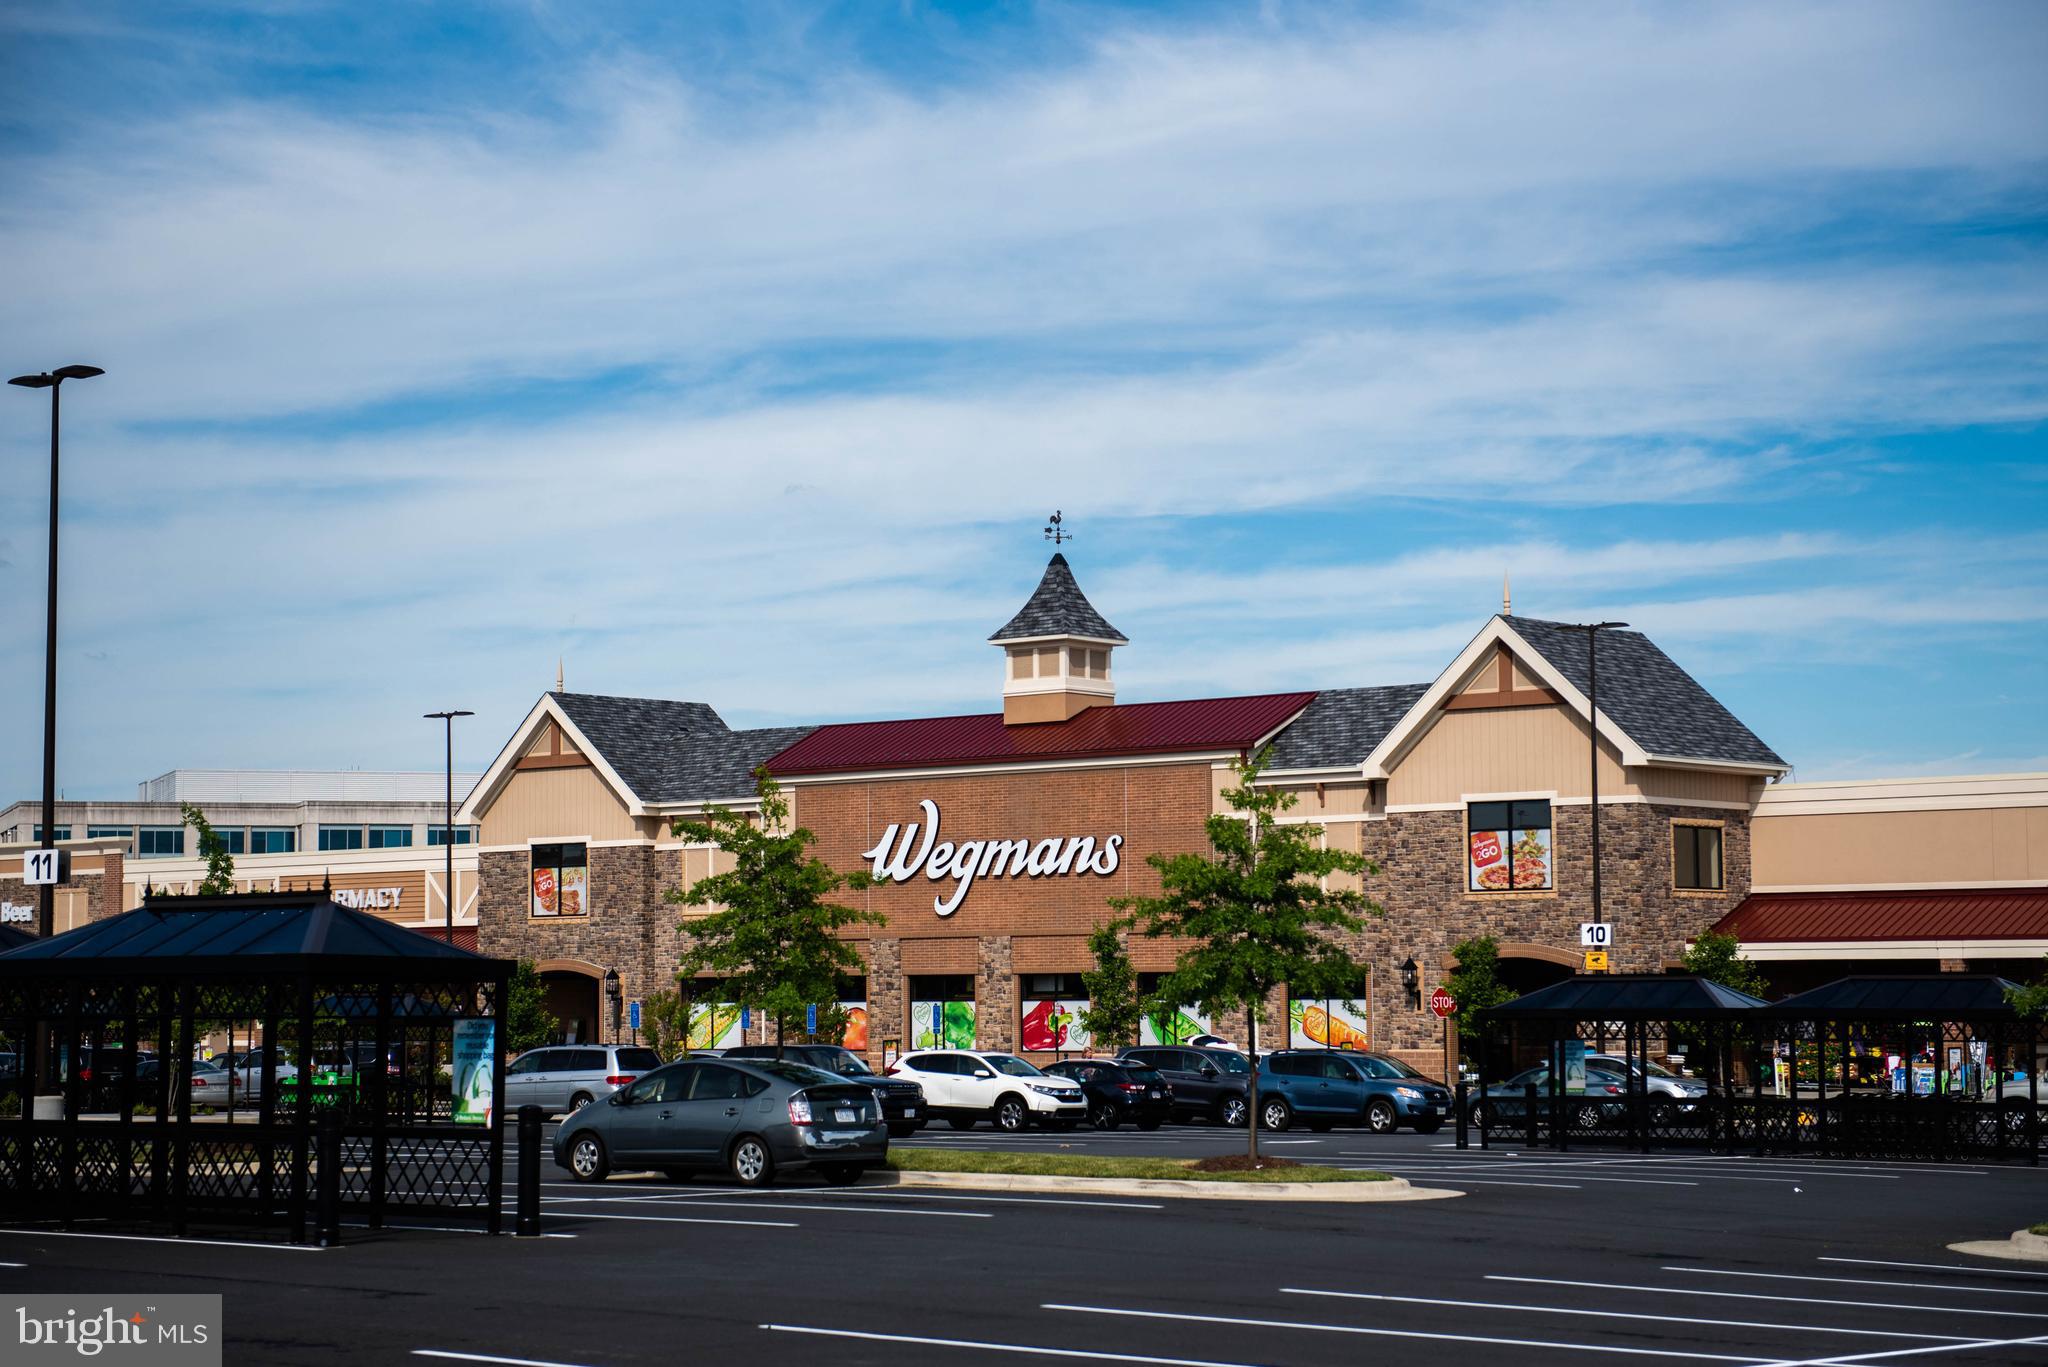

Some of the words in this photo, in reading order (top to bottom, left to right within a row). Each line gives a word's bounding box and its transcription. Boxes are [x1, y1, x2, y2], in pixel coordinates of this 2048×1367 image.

[861, 799, 1123, 916] Wegmans
[1476, 846, 1498, 861] 2GO
[31, 854, 51, 880] 11
[330, 887, 403, 909] RMACY
[1, 902, 34, 922] Beer
[1587, 926, 1606, 943] 10
[1433, 996, 1455, 1008] STOP
